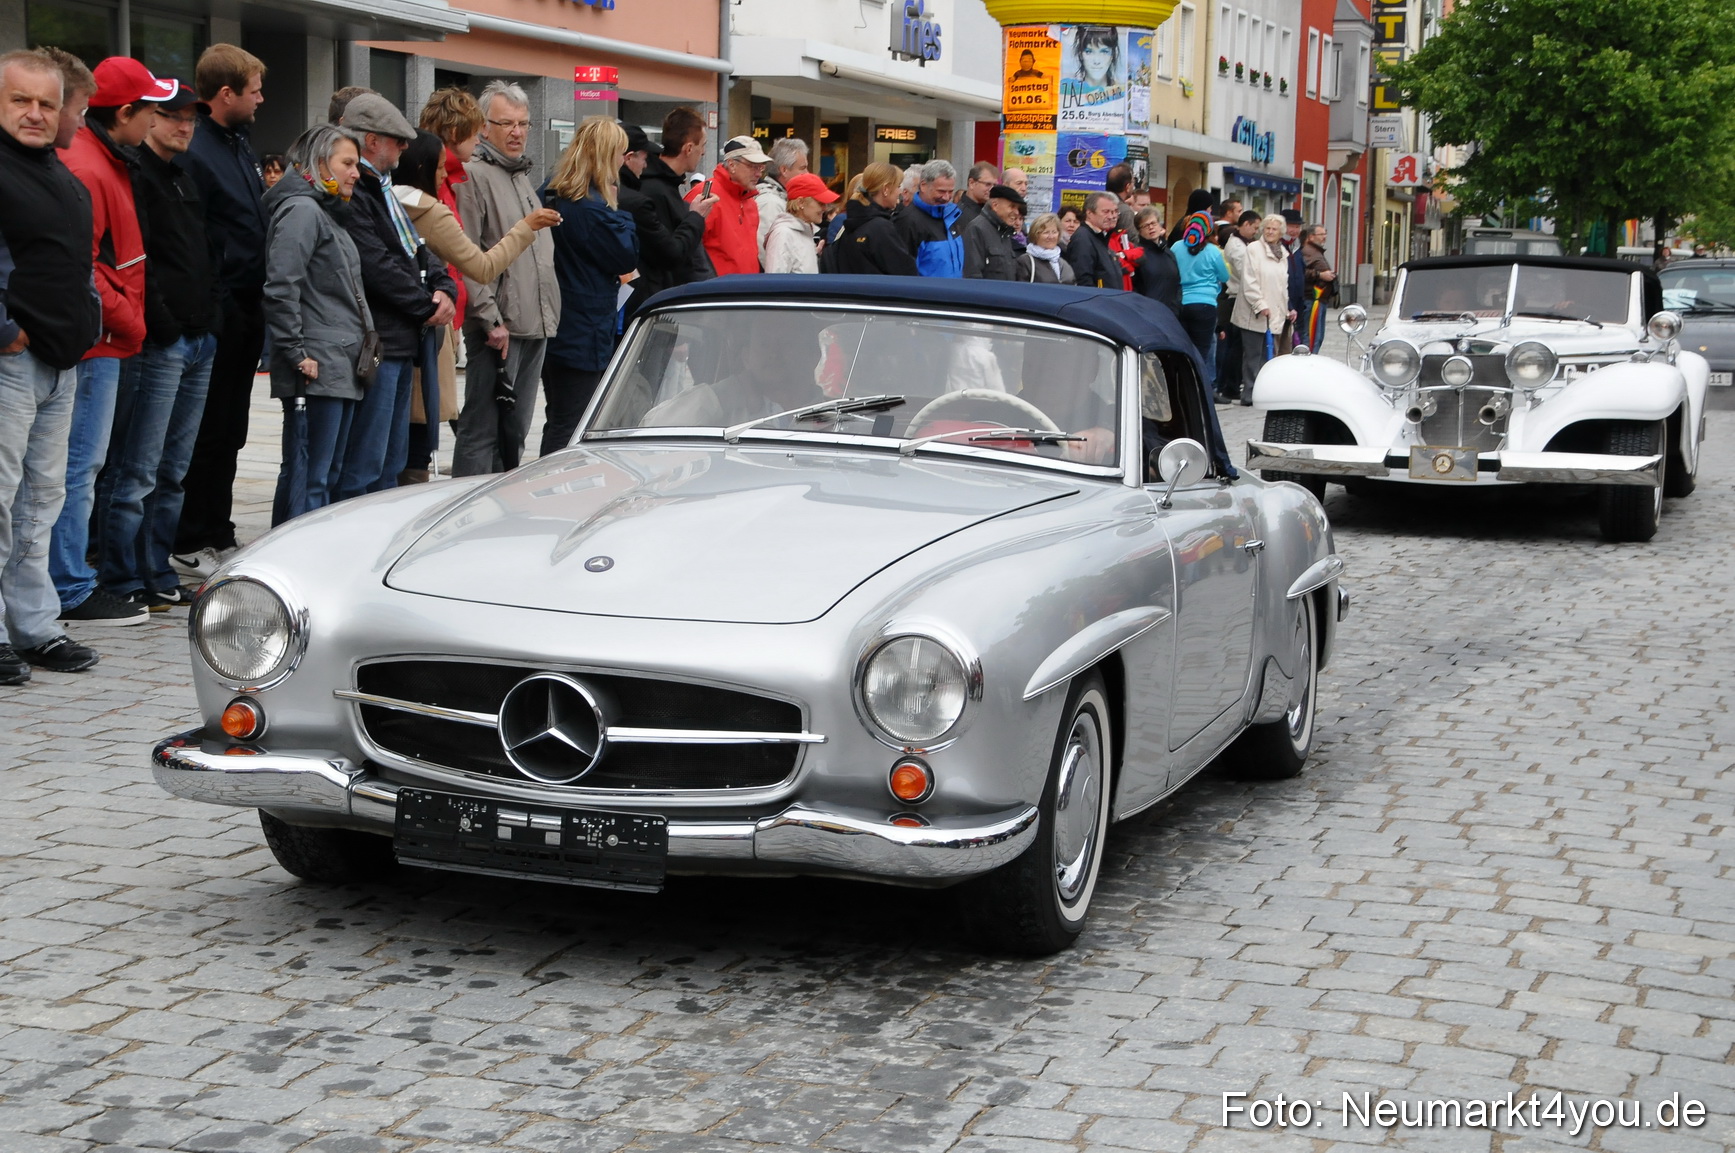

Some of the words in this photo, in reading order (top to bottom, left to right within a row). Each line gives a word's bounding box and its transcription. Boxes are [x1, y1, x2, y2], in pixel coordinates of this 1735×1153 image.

[1009, 29, 1048, 38] Neumarkt
[1008, 39, 1059, 49] Flohmarkt
[1010, 83, 1049, 92] Samstag
[580, 90, 601, 98] HotSpot
[1062, 80, 1085, 109] ZAZ
[1087, 90, 1110, 106] OPEN
[1010, 94, 1047, 105] 01.06.
[1005, 113, 1053, 123] Volksfestplatz
[1061, 110, 1089, 120] 25.6.
[876, 128, 917, 140] FRIES
[1026, 165, 1038, 173] Juni
[1038, 166, 1054, 174] 2013
